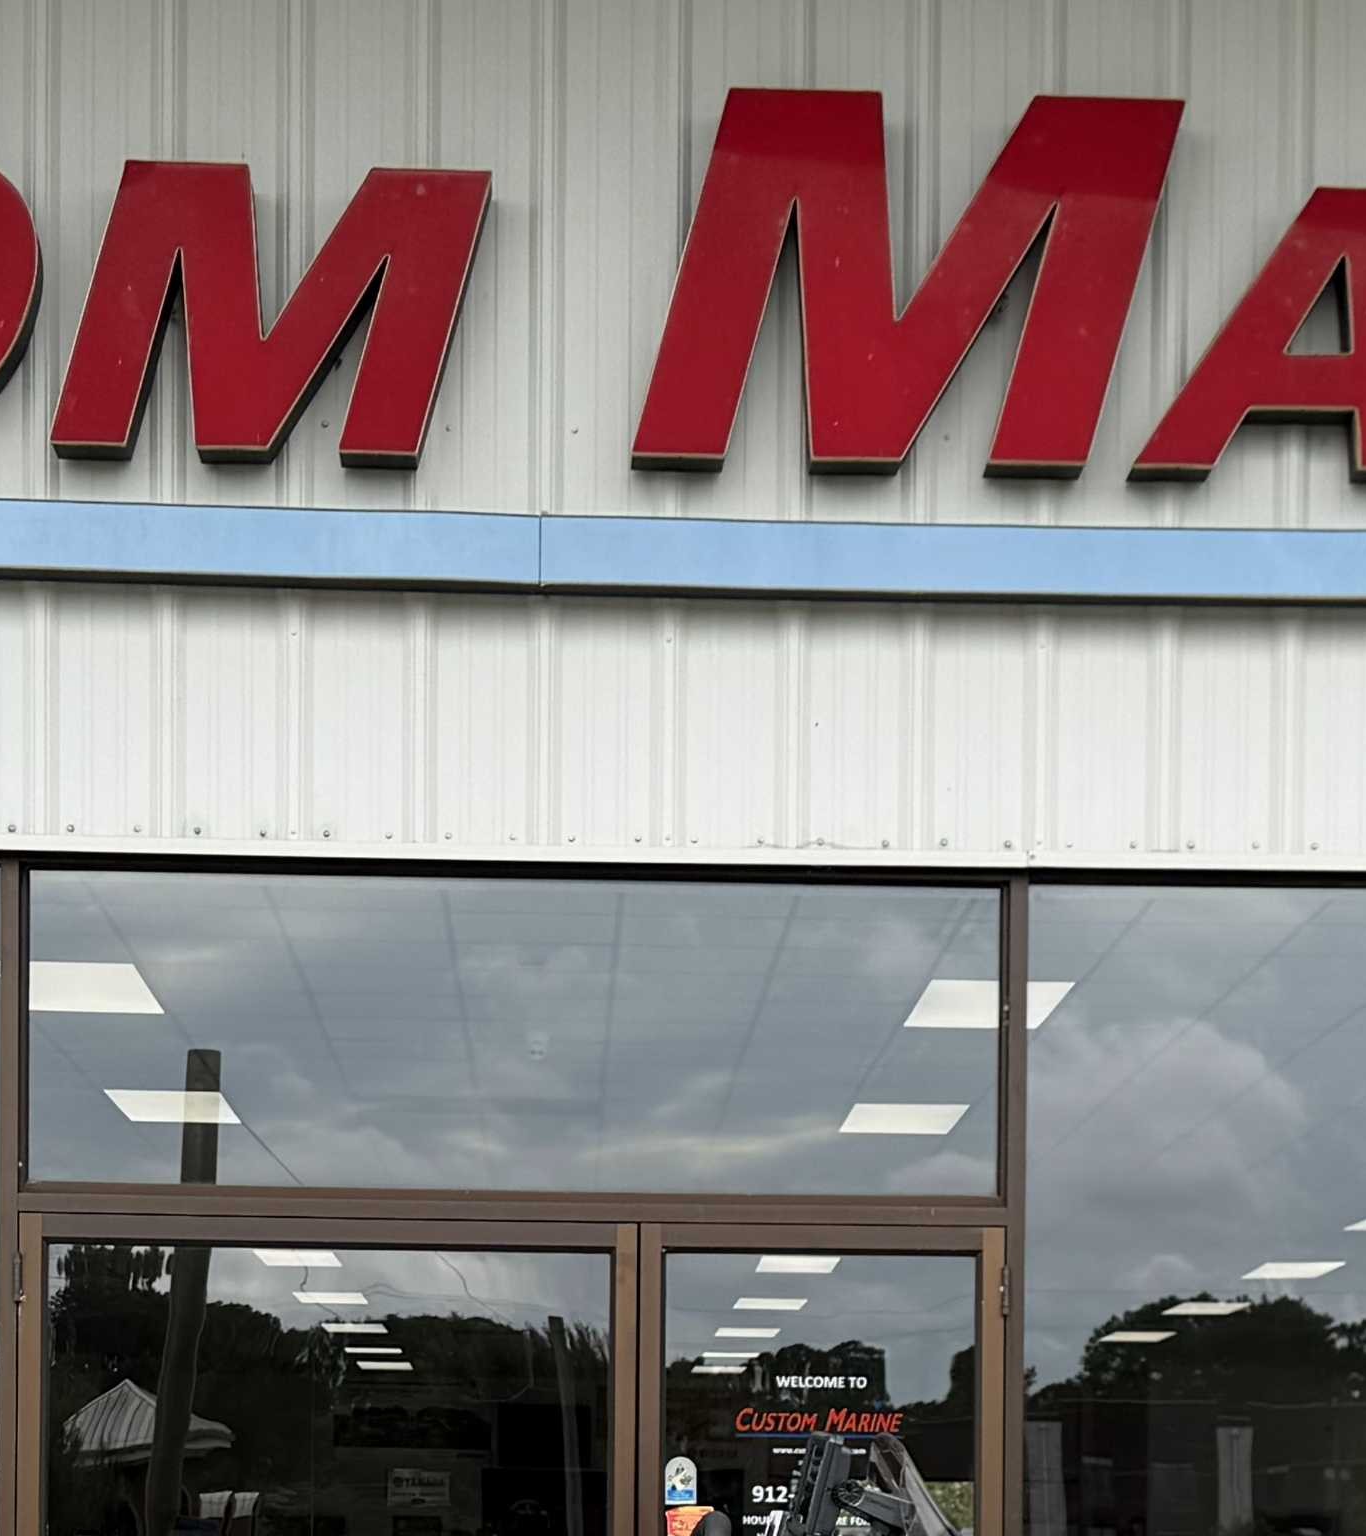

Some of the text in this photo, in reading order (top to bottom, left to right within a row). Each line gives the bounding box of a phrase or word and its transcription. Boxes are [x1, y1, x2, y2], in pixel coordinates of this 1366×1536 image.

[776, 1375, 867, 1389] WELCOME TO
[735, 1407, 905, 1433] CUSTOM MARINE
